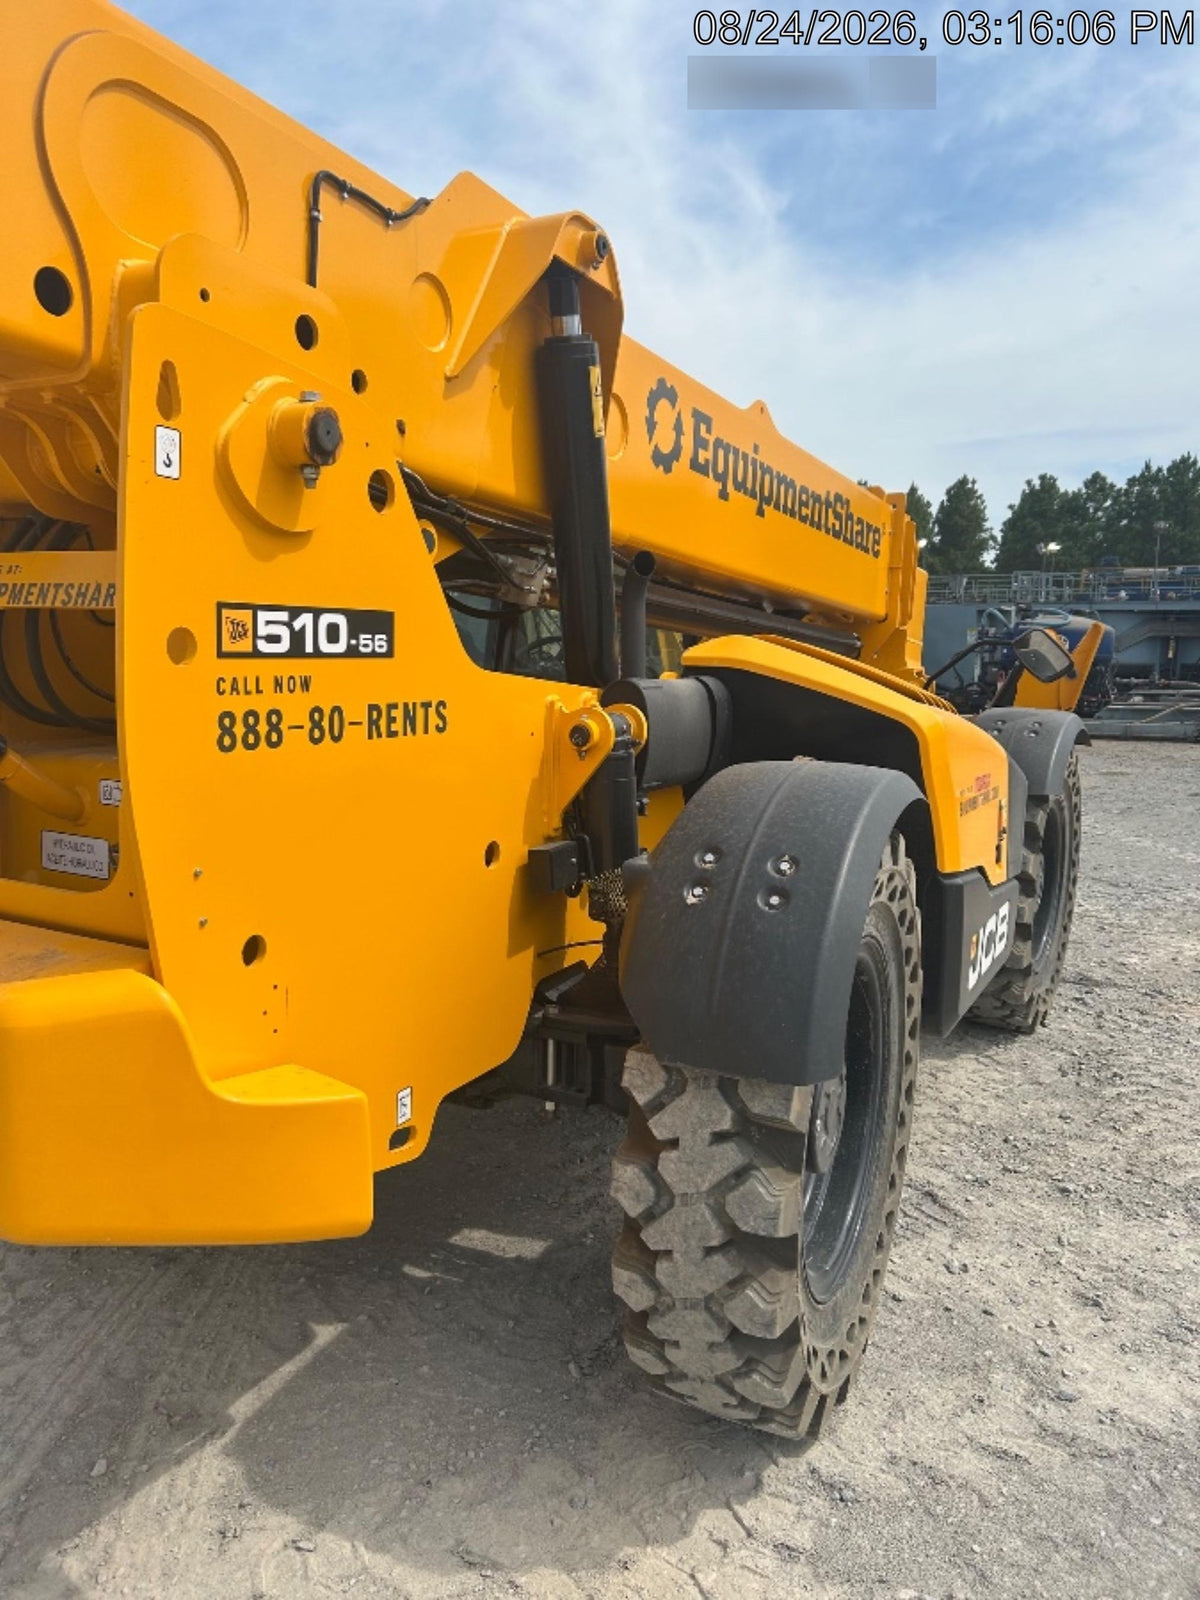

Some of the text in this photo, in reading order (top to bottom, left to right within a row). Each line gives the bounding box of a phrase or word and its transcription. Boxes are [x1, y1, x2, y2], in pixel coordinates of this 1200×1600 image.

[689, 406, 881, 559] EquipmentShare
[255, 610, 388, 654] 510-56
[216, 675, 313, 696] CALL NOW
[216, 700, 448, 753] 888-80-RENTS
[967, 901, 1010, 991] JCB
